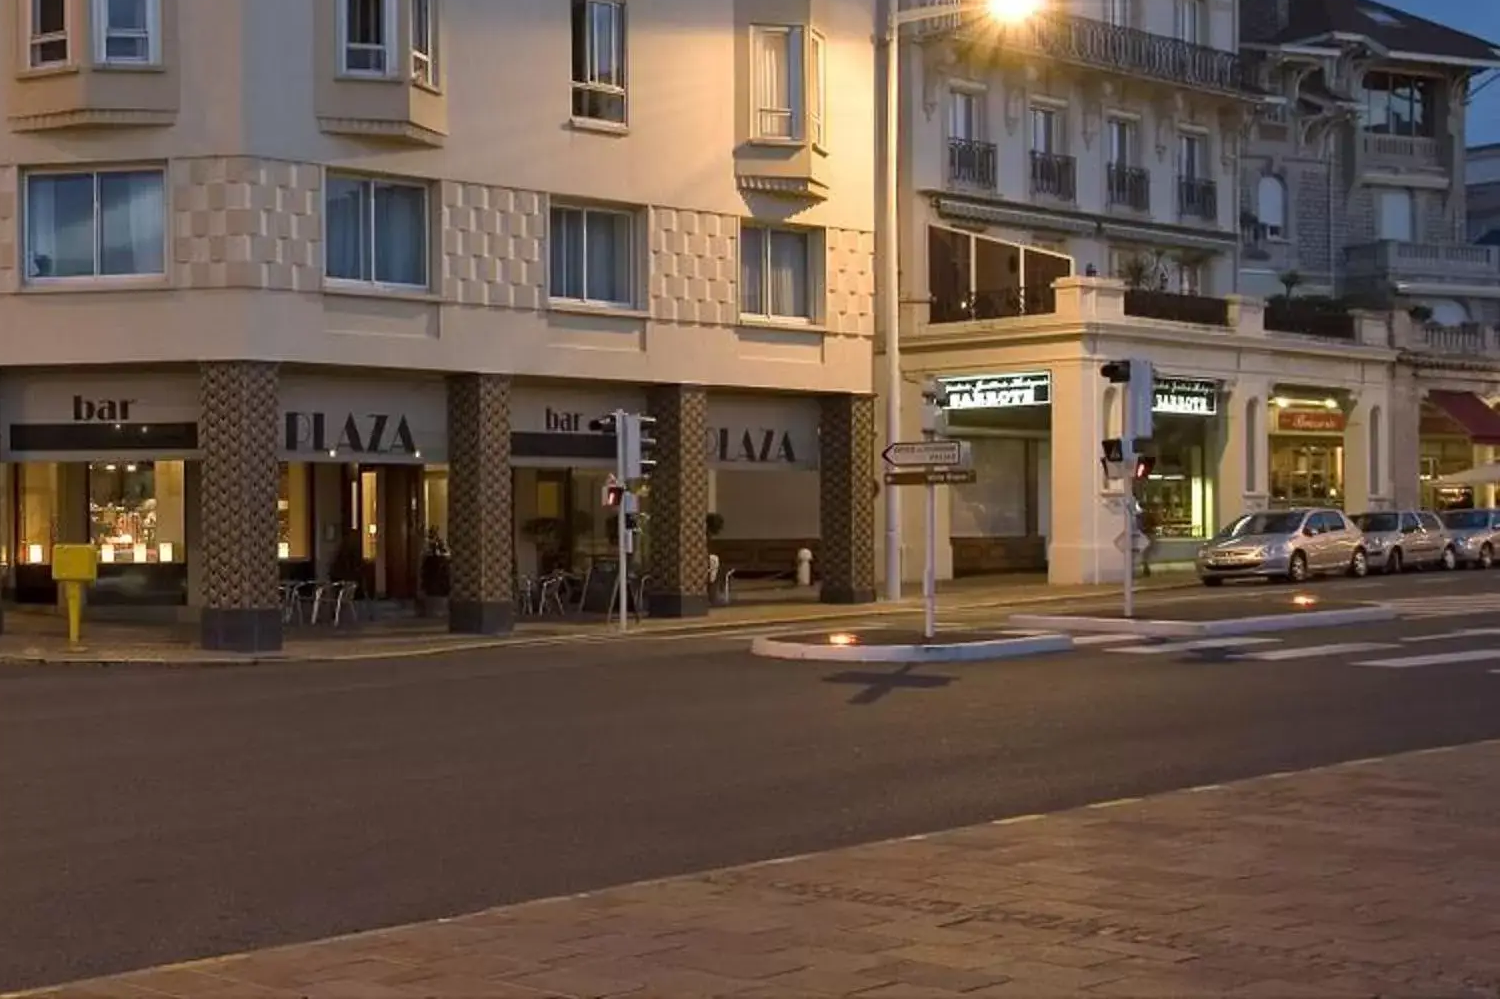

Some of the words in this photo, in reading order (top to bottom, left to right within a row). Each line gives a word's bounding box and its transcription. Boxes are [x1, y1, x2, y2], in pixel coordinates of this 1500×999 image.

[73, 395, 138, 421] bar
[545, 407, 584, 431] bar
[285, 412, 417, 453] PLAZA
